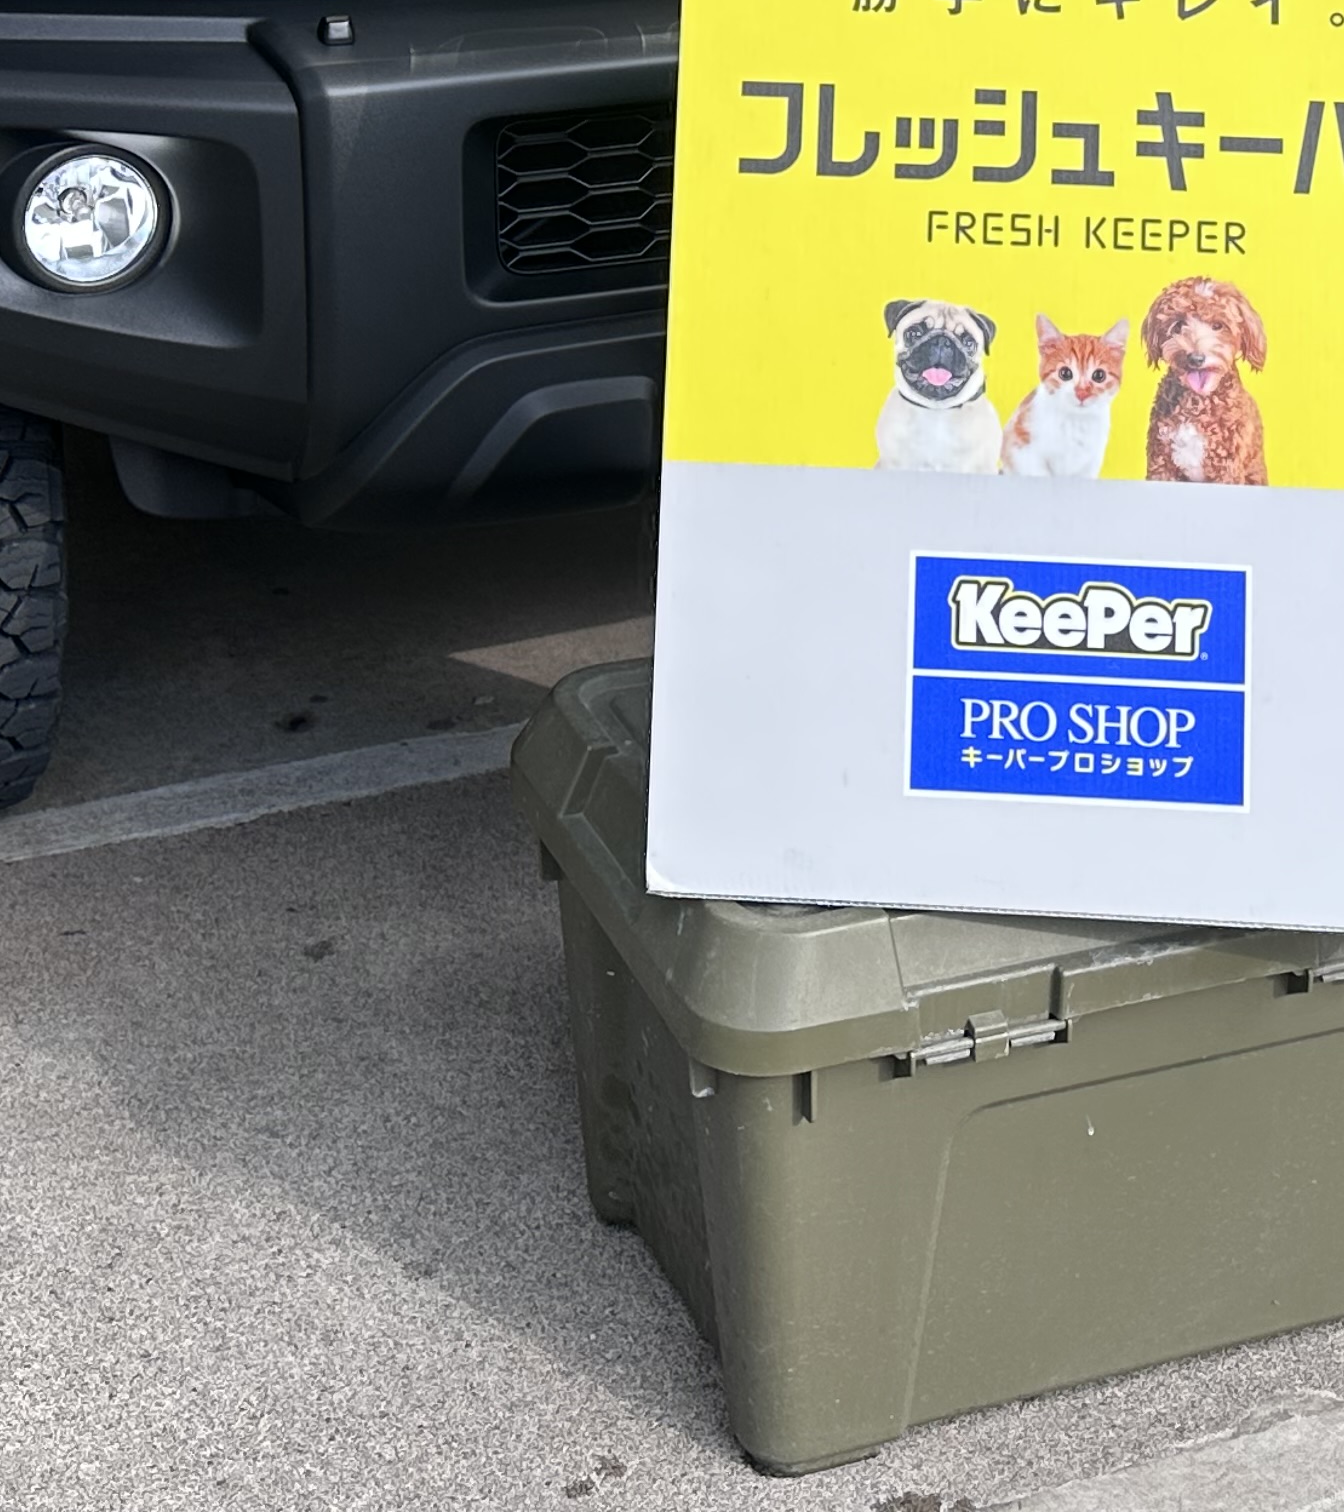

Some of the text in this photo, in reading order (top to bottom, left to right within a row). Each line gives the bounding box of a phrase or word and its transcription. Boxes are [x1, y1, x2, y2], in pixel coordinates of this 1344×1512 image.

[927, 210, 1246, 255] FRESH KEEPER
[950, 577, 1211, 659] KeePer
[960, 698, 1196, 748] PRO SHOP
[961, 746, 1194, 778] キーパープロショップ
